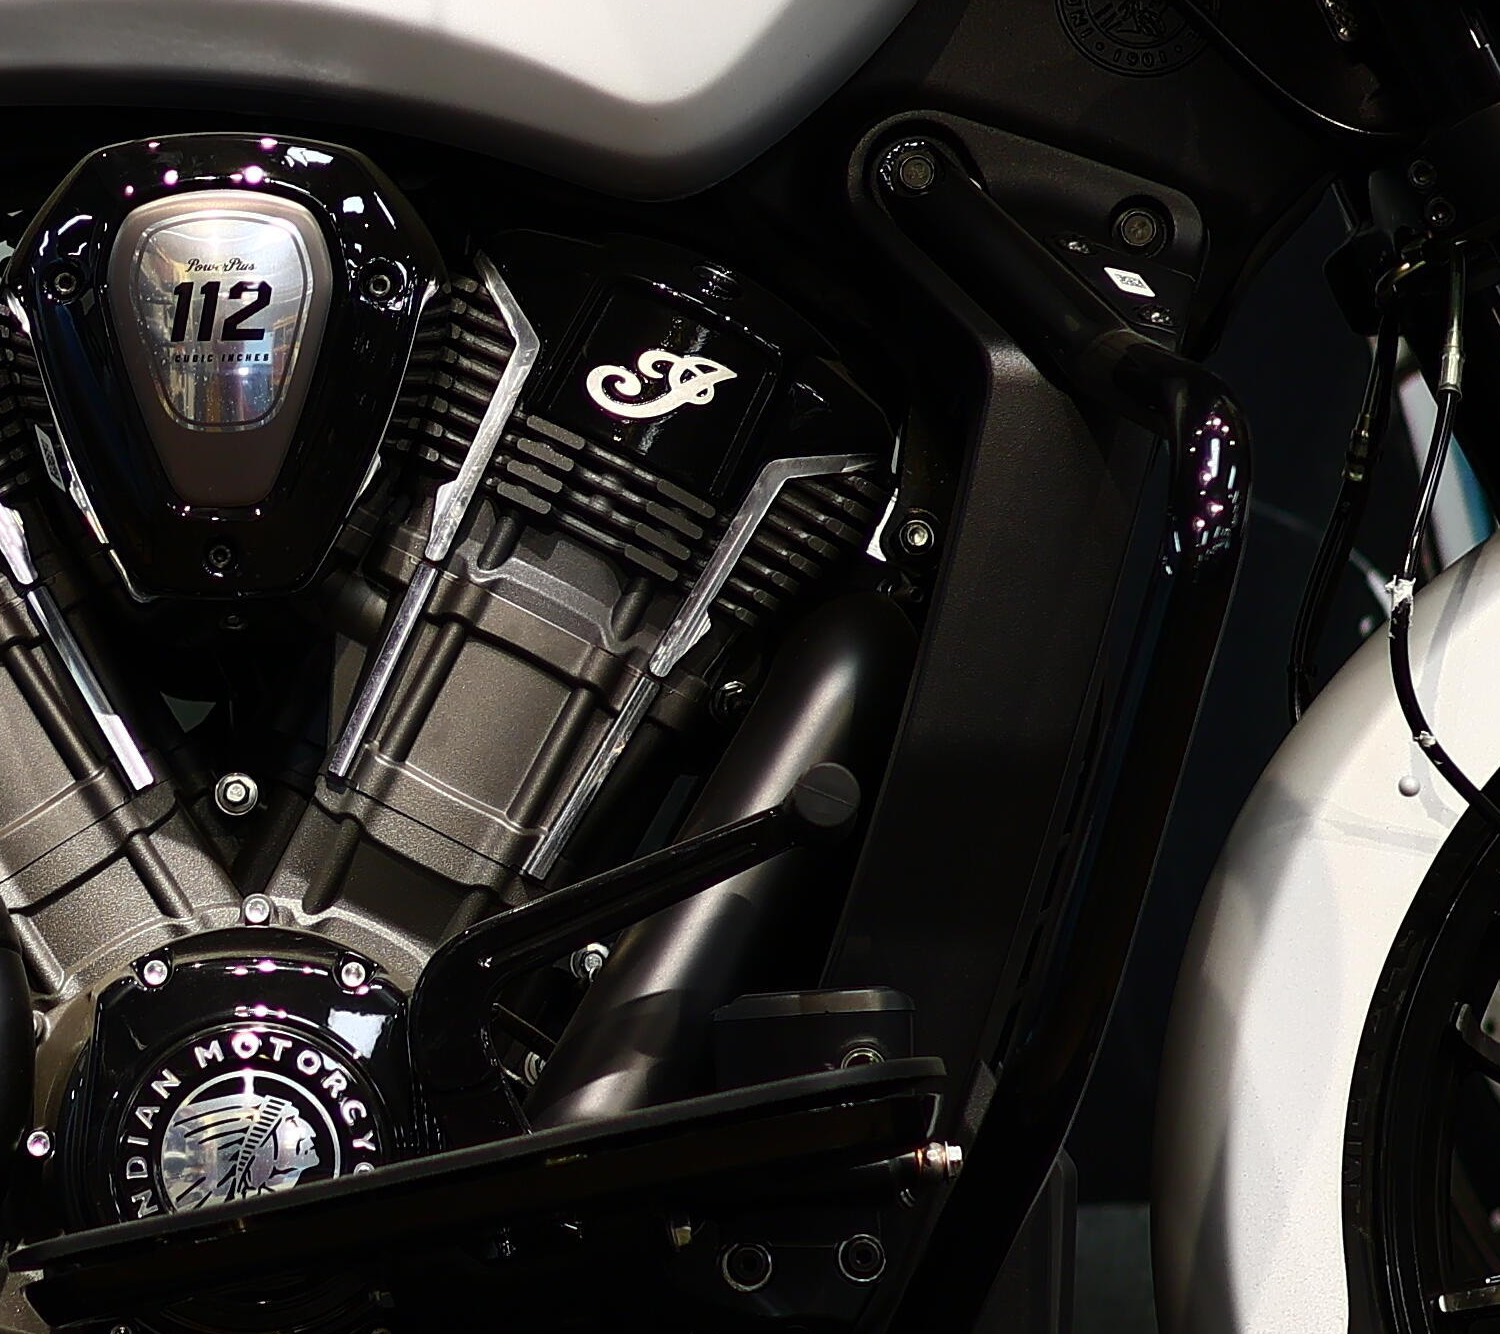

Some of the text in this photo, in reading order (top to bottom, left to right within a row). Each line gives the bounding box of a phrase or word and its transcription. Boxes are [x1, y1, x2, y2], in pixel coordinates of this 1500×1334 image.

[170, 280, 273, 343] 112
[174, 353, 270, 363] CUBIC INCHES
[126, 1068, 182, 1218] NDIAN
